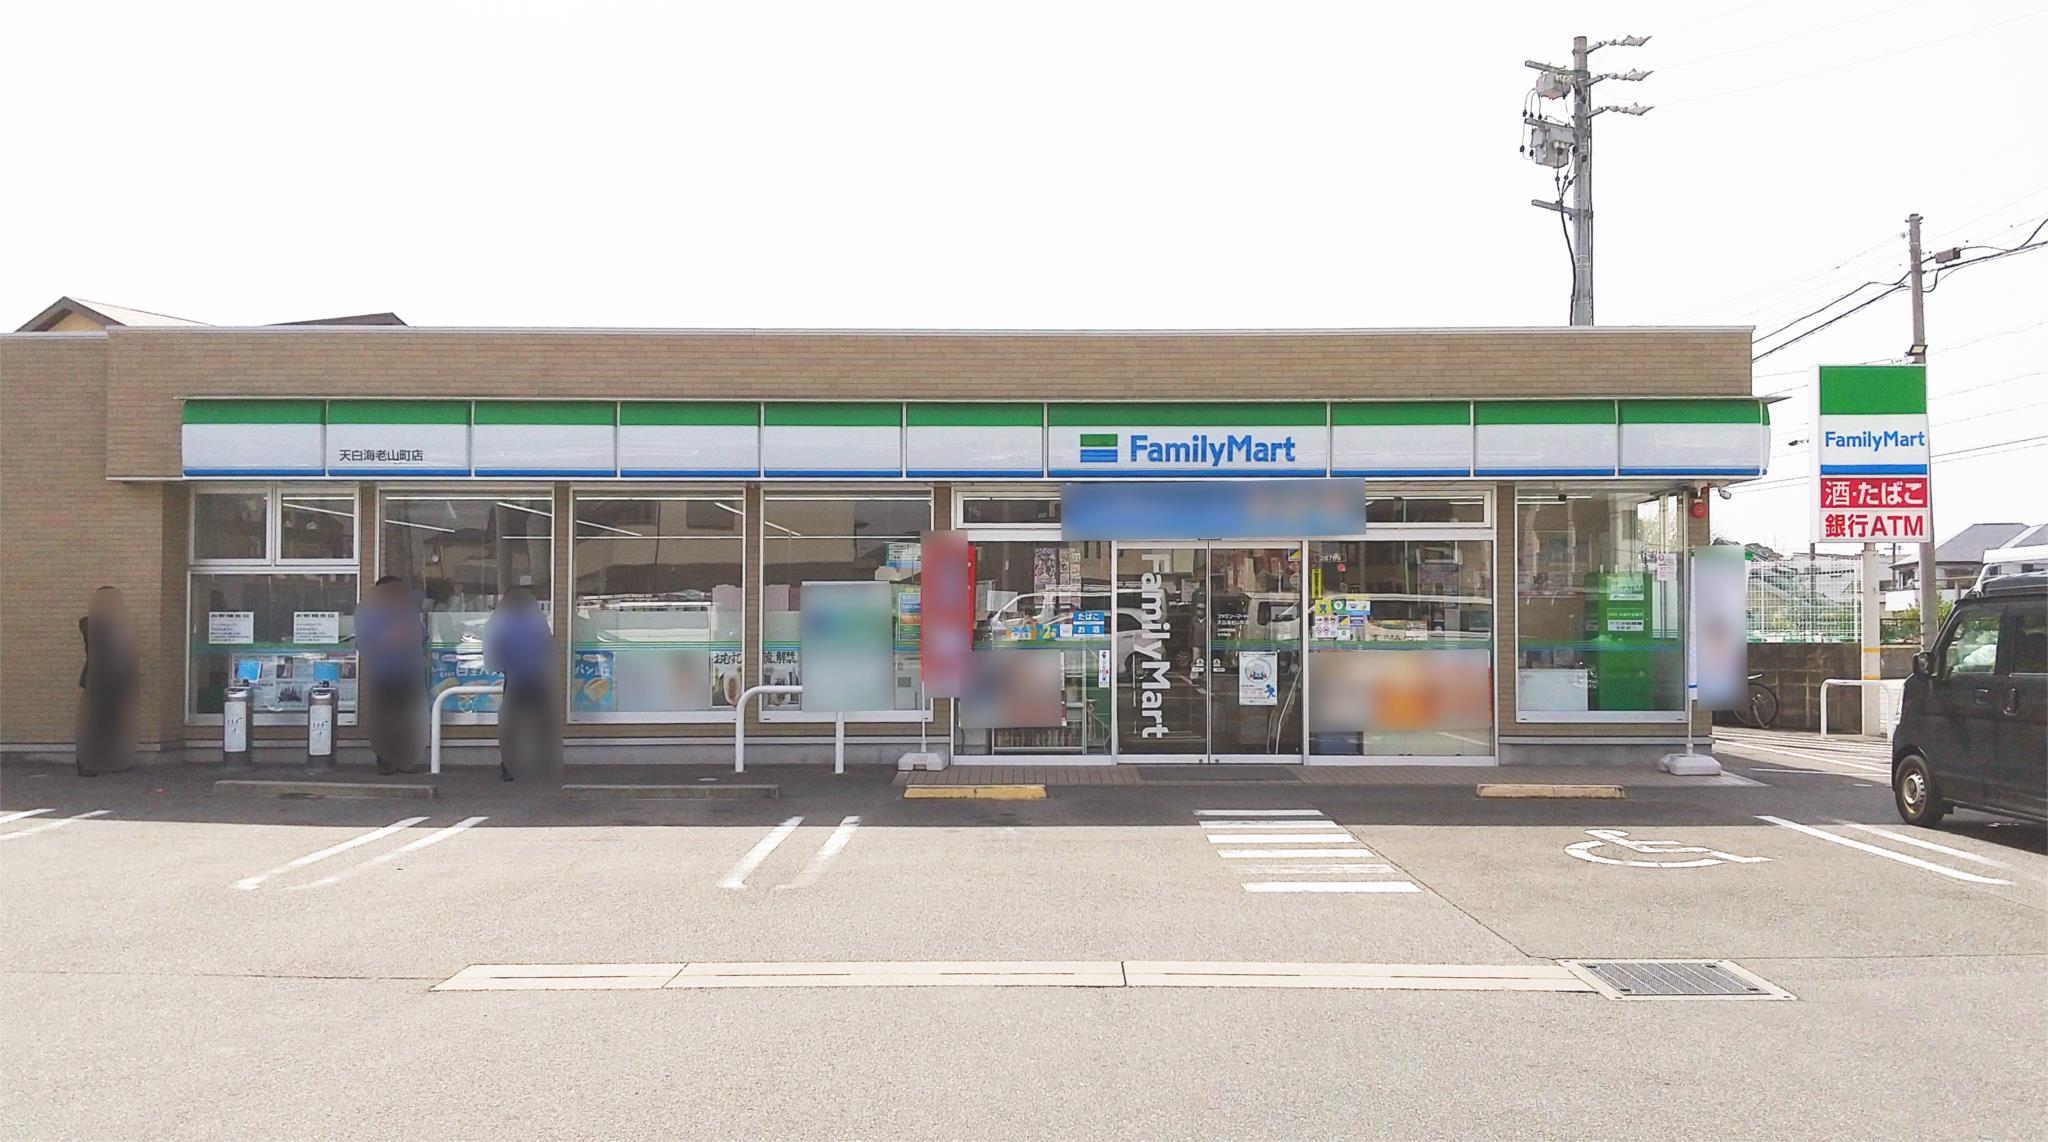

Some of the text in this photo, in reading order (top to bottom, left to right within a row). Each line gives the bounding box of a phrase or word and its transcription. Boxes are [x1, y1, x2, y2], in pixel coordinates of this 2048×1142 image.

[1130, 434, 1296, 466] FamilyMart
[1824, 431, 1925, 452] FamilyMart
[339, 449, 424, 462] 天白海老山町店
[1825, 481, 1924, 506] 酒・たばこ
[1825, 514, 1923, 537] 銀行ATM
[1133, 553, 1171, 738] FamilyMart
